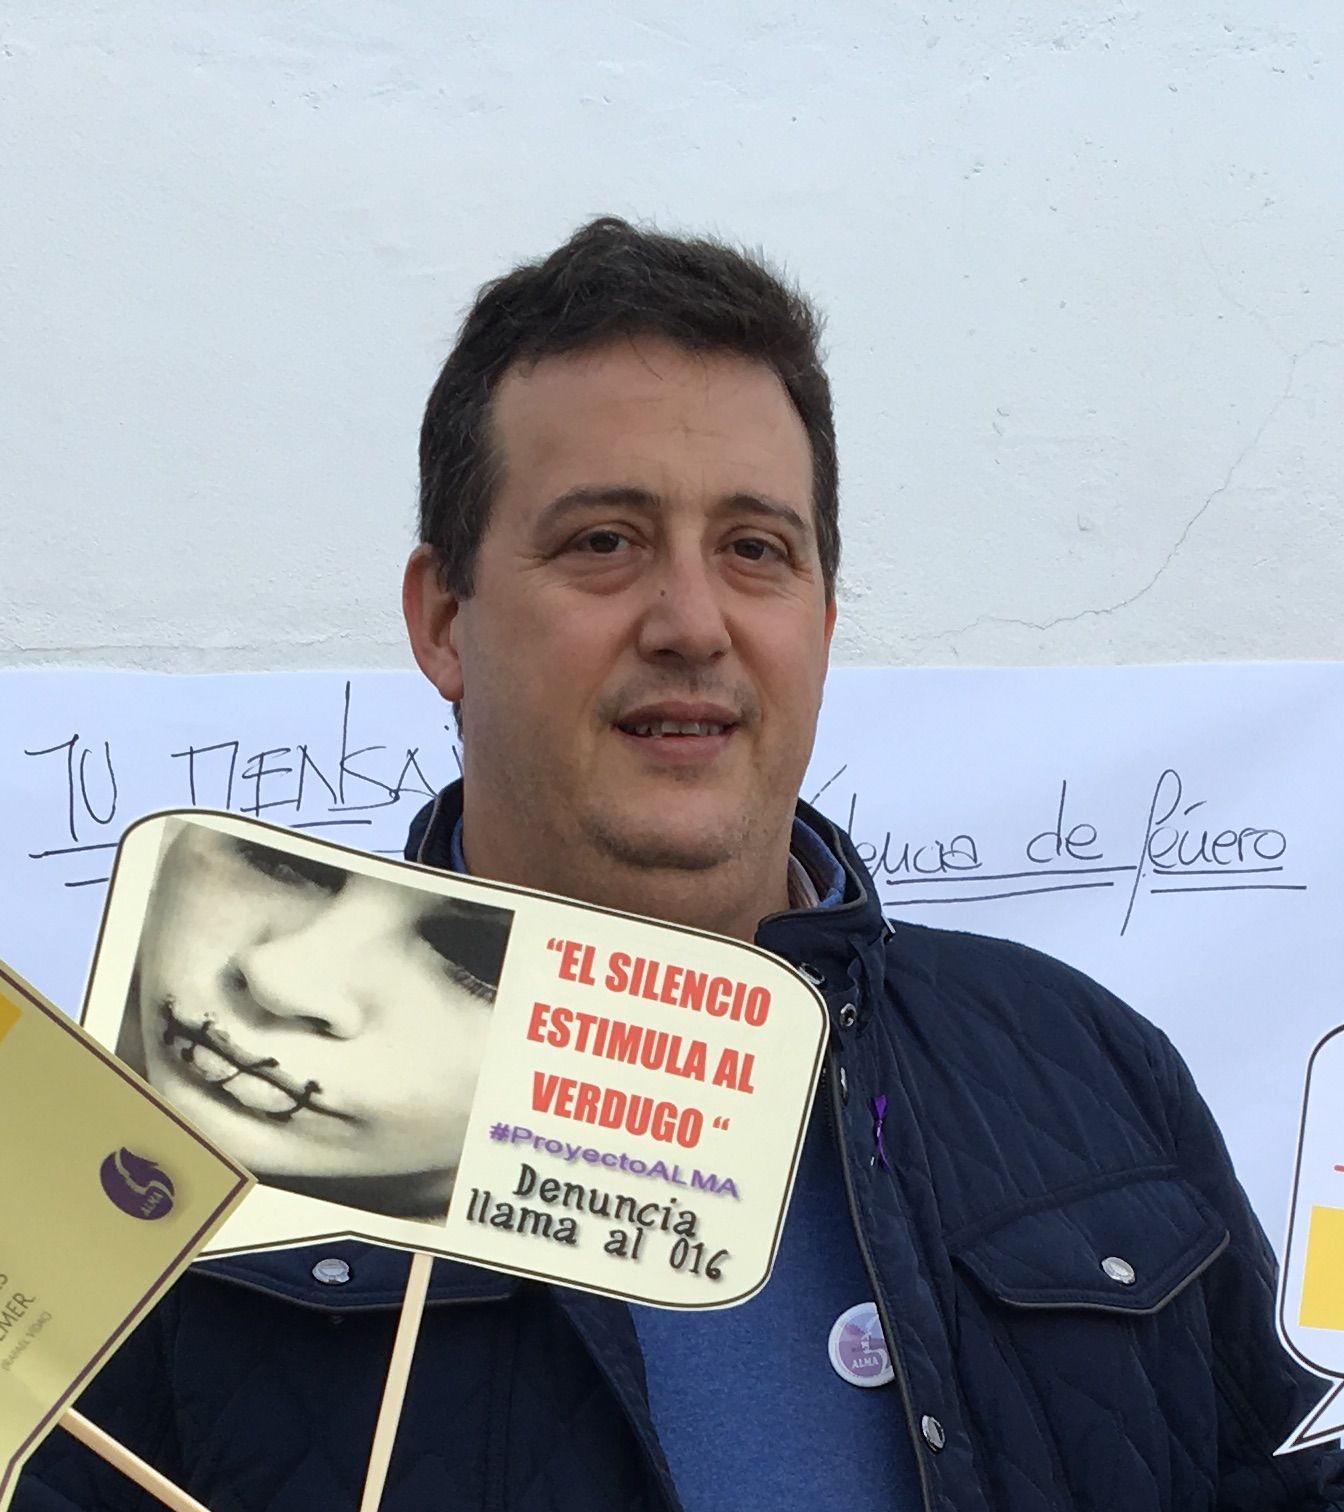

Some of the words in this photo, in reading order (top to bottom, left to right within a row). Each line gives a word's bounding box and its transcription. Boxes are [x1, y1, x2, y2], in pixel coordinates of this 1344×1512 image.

[1027, 781, 1103, 863] de
[605, 952, 771, 1027] SILENCIO
[526, 1002, 707, 1082] ESTIMULA
[712, 1048, 756, 1094] AL
[531, 1071, 703, 1148] VERDUGO
[489, 1122, 740, 1198] #ProyectoALMA
[466, 1188, 578, 1245] llama
[603, 1226, 643, 1259] al
[669, 1237, 731, 1281] 016
[513, 1163, 698, 1237] Denuncia
[852, 1356, 879, 1369] ALMA
